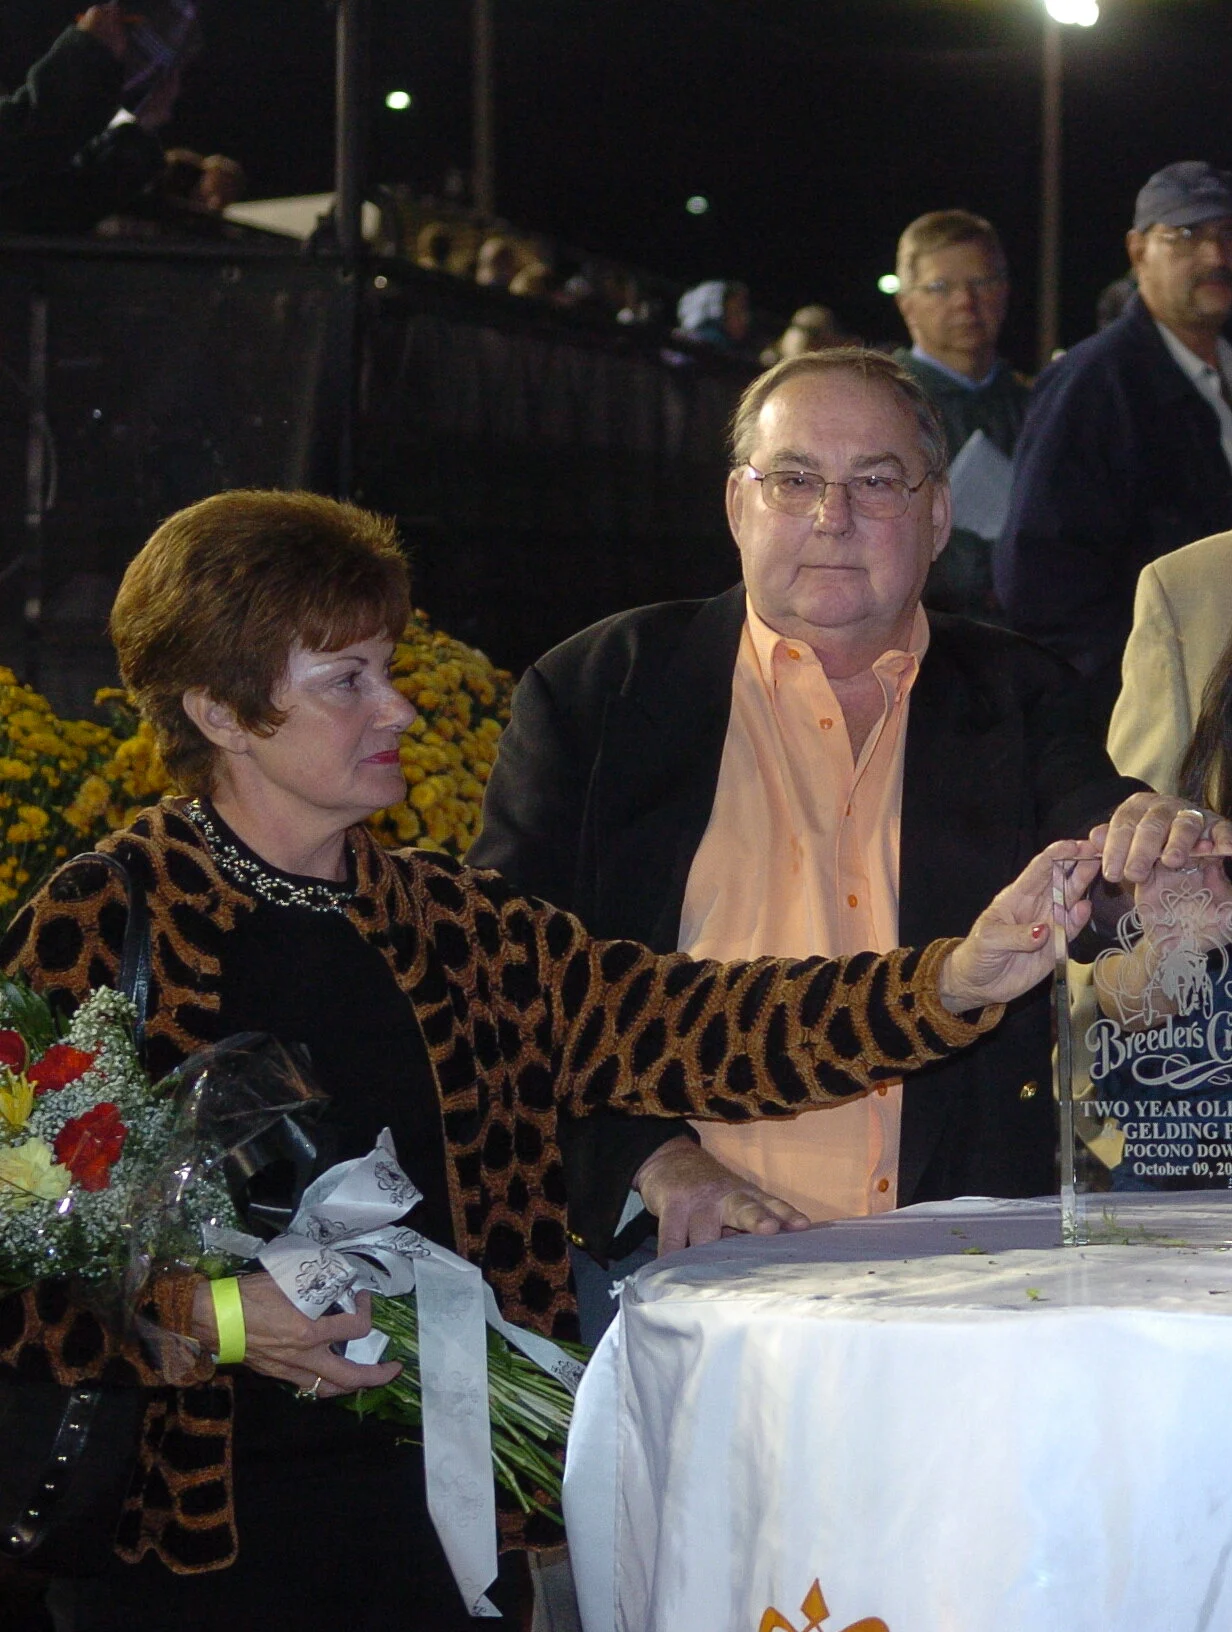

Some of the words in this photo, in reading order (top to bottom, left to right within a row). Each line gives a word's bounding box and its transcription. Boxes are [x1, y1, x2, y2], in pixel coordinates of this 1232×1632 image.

[1080, 1100, 1130, 1118] TWO
[1134, 1100, 1191, 1118] YEAR
[1123, 1122, 1218, 1140] GELDING
[1124, 1143, 1194, 1158] POCONO
[1133, 1161, 1189, 1176] October
[1192, 1161, 1213, 1178] 09,
